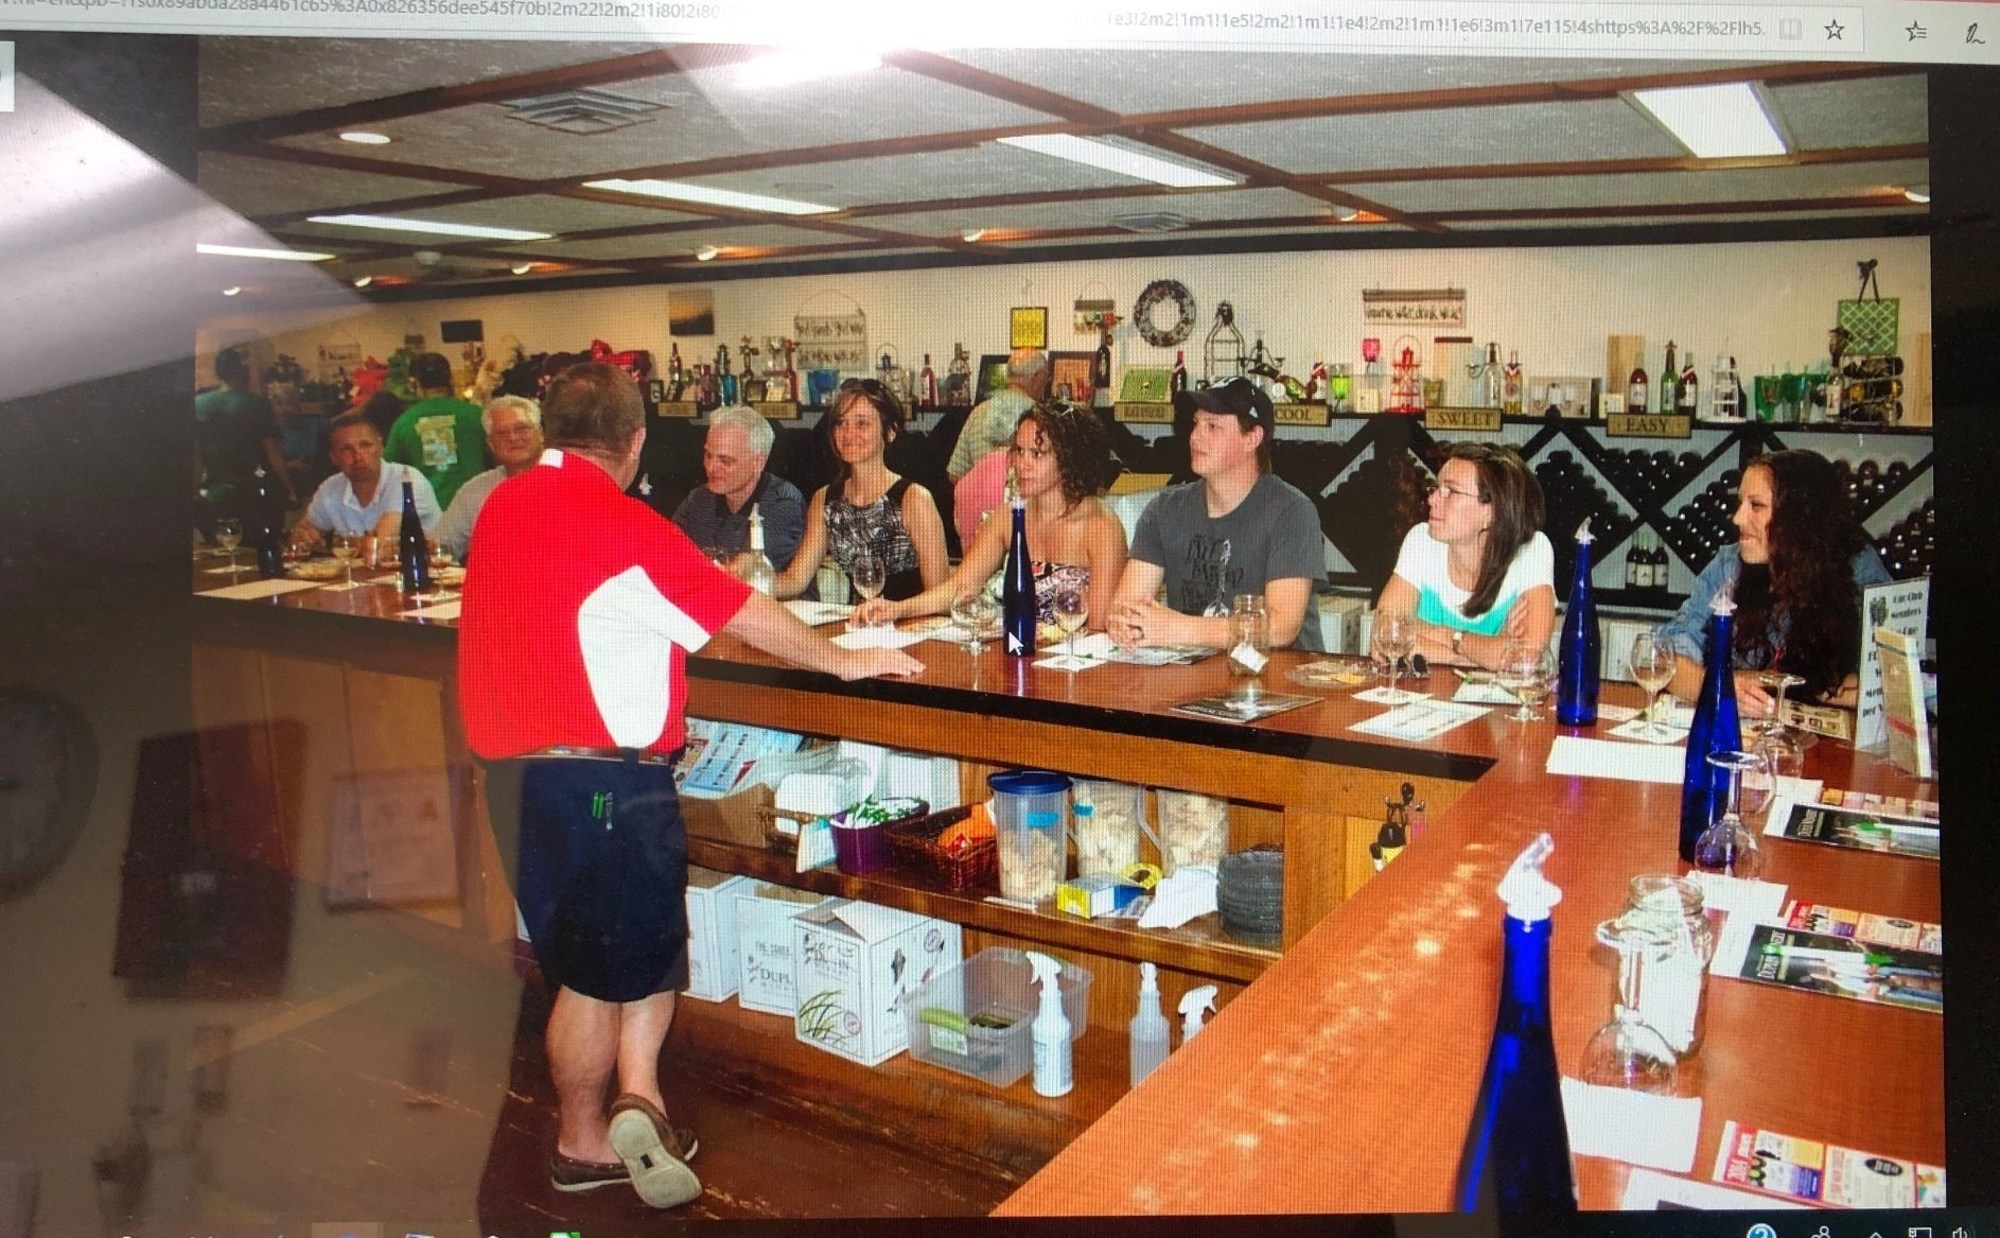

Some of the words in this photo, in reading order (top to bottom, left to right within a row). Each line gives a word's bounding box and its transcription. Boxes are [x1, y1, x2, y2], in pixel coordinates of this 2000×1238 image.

[1274, 407, 1311, 421] COOL
[1438, 411, 1492, 427] SWEET
[1625, 418, 1669, 432] EASY
